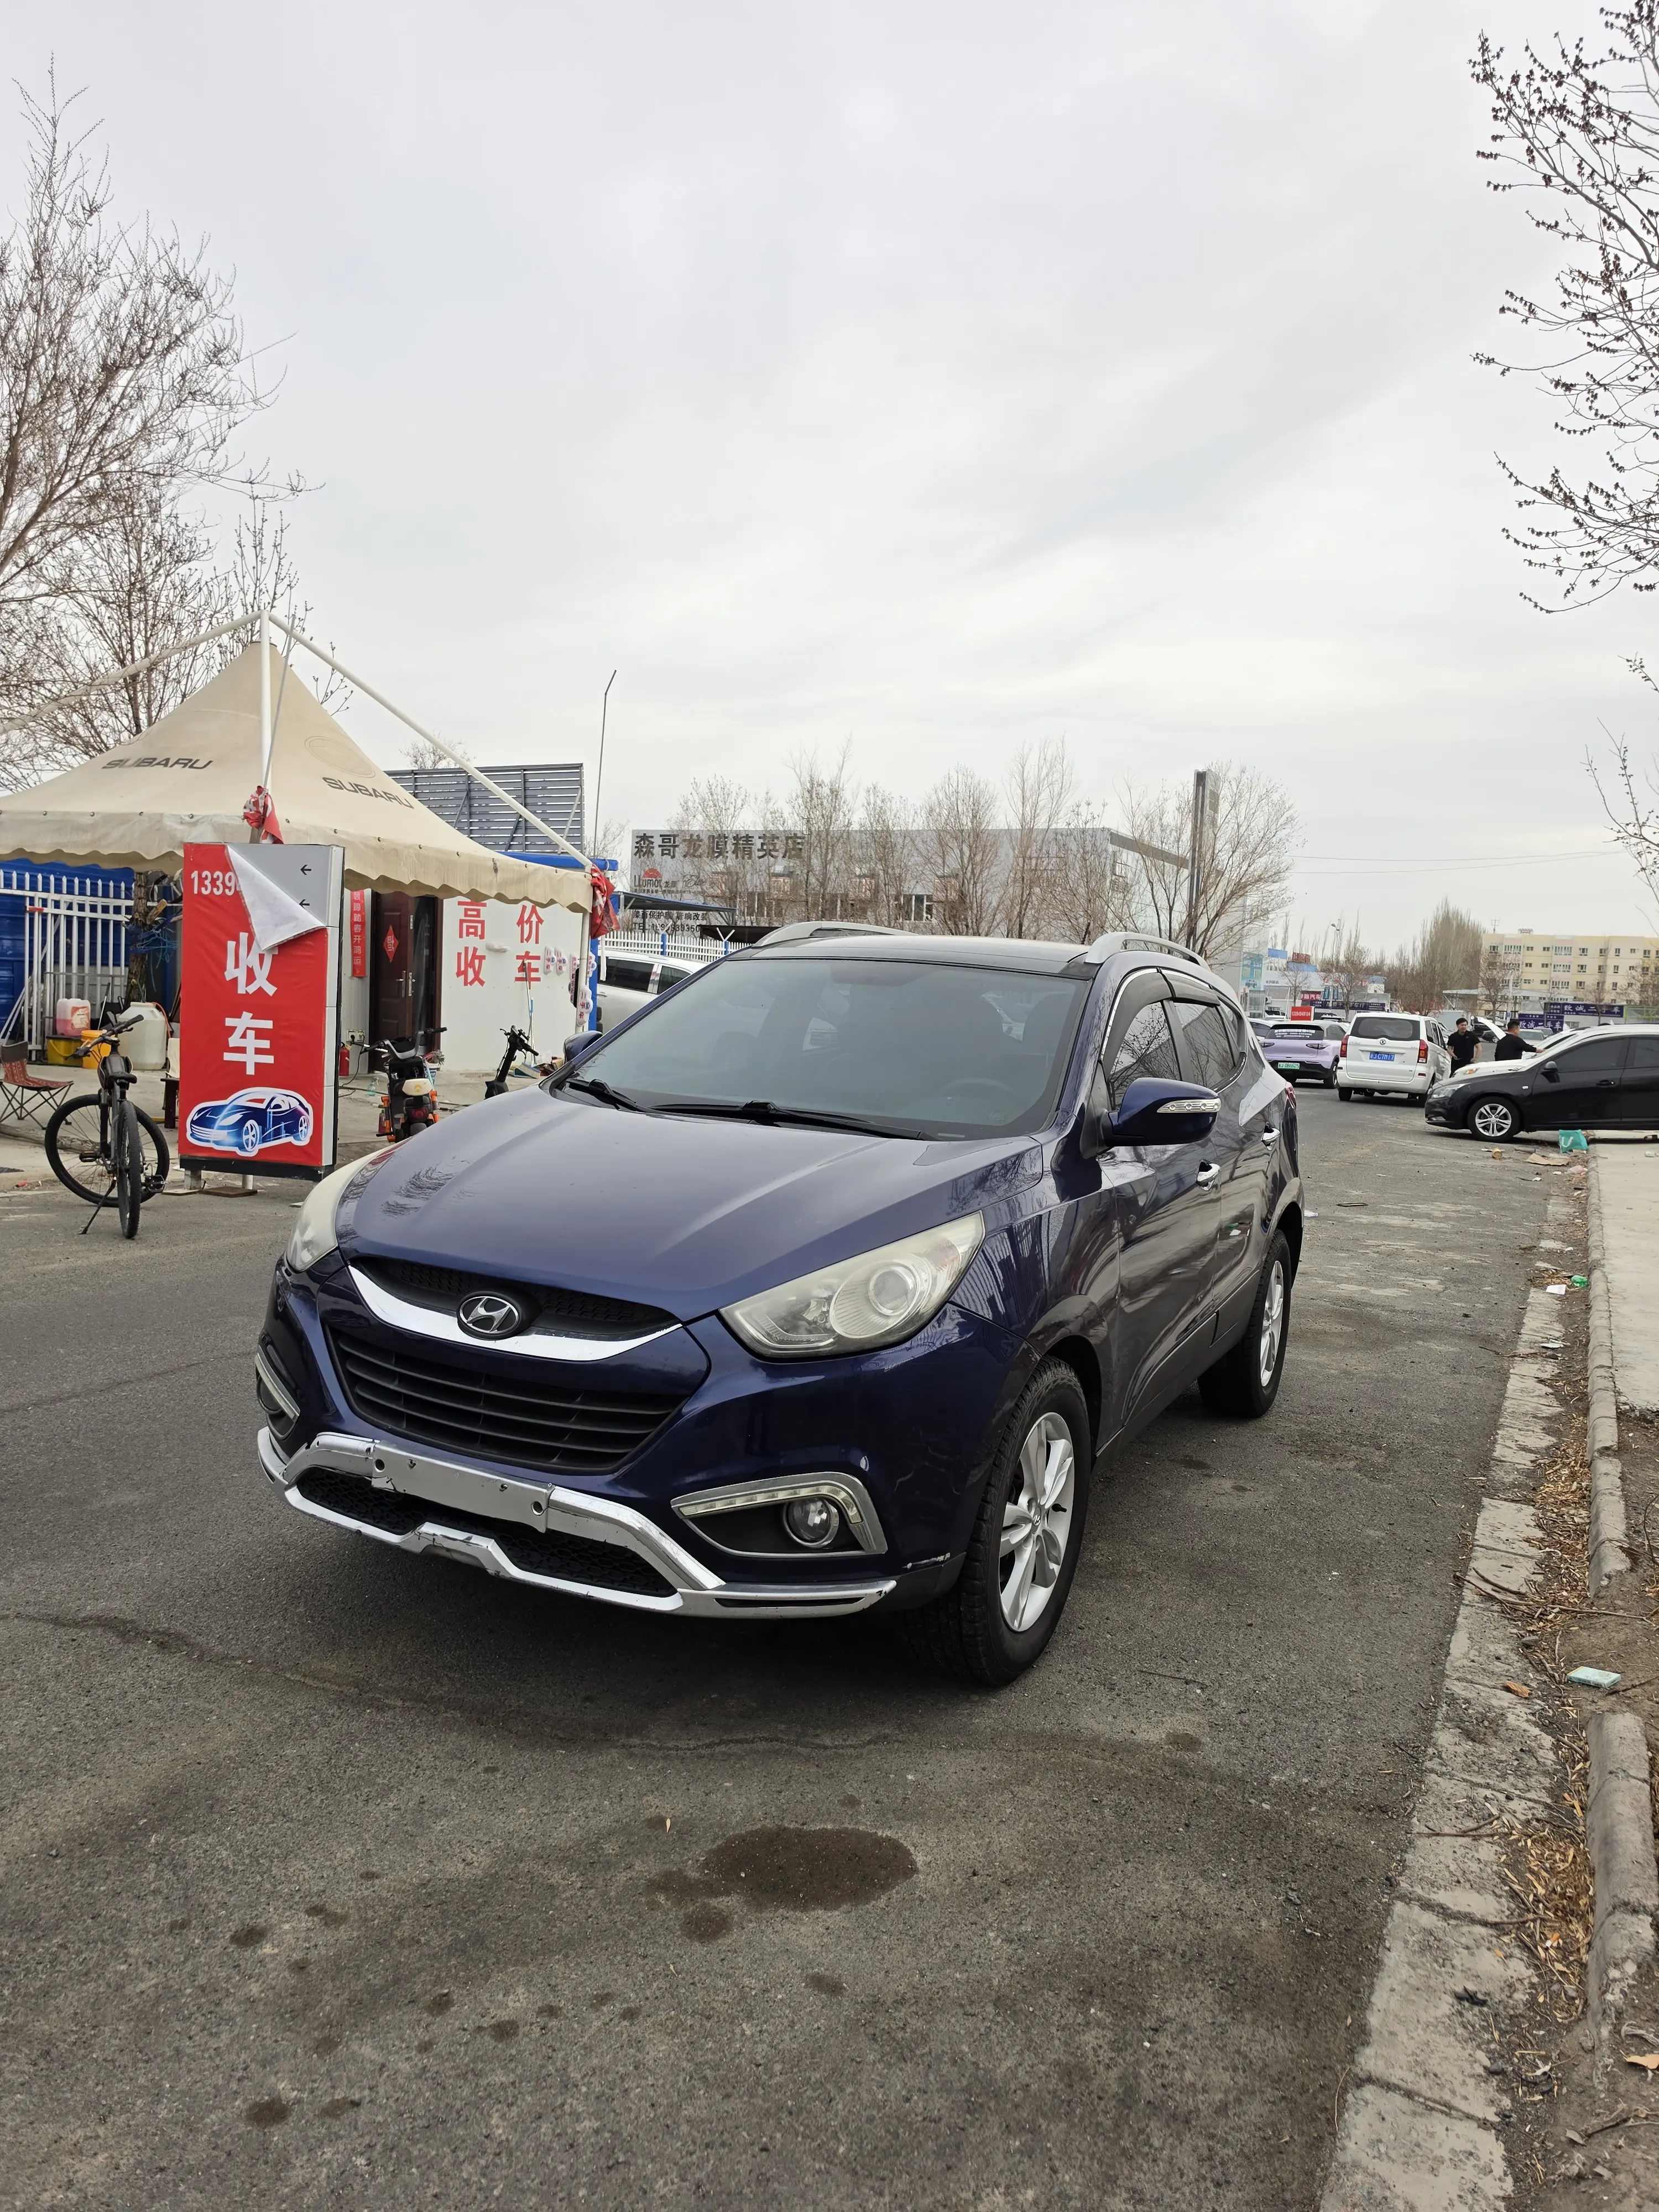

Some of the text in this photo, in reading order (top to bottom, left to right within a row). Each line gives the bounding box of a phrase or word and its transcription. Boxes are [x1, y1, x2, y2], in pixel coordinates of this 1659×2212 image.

[101, 758, 213, 769] SUBARU
[322, 777, 414, 809] SUBARU
[191, 870, 242, 896] 1339
